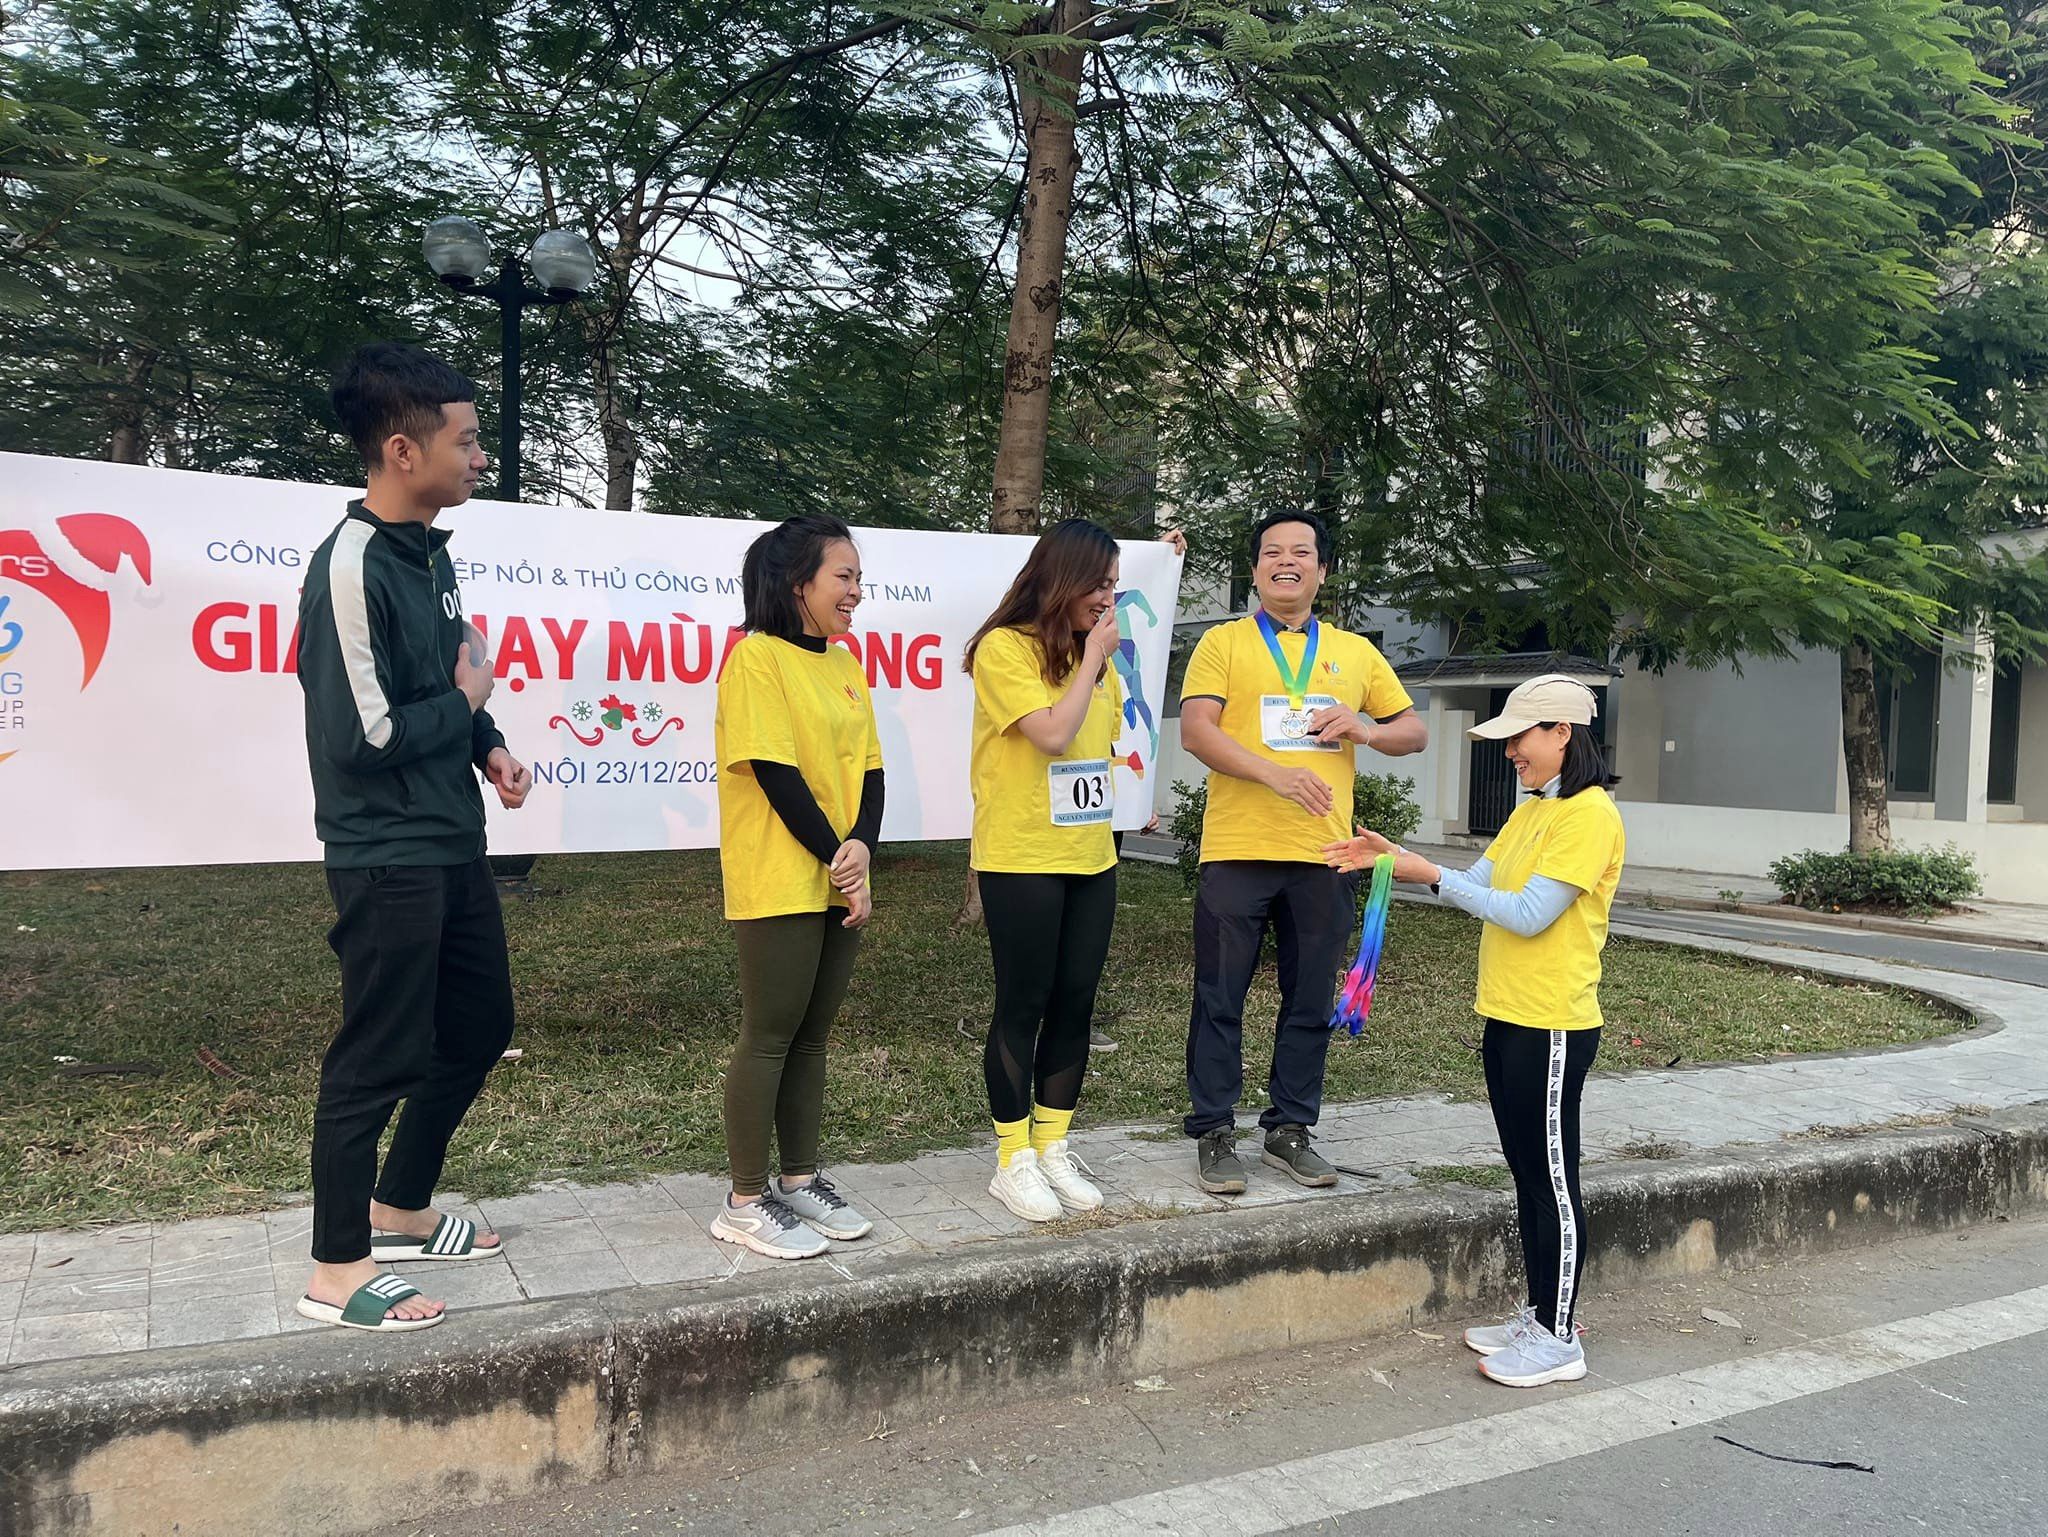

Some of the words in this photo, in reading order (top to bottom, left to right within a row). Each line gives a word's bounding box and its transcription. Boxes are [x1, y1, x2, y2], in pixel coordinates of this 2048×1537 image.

[207, 540, 301, 567] CÔNG
[496, 559, 542, 585] NỔI
[552, 568, 568, 586] &
[574, 566, 626, 589] THỦ
[635, 570, 708, 593] CÔNG
[885, 585, 932, 602] NAM
[534, 757, 585, 789] NỘI
[596, 761, 719, 784] 23/12/202
[1073, 776, 1104, 809] 03
[1551, 1060, 1561, 1078] PUMA
